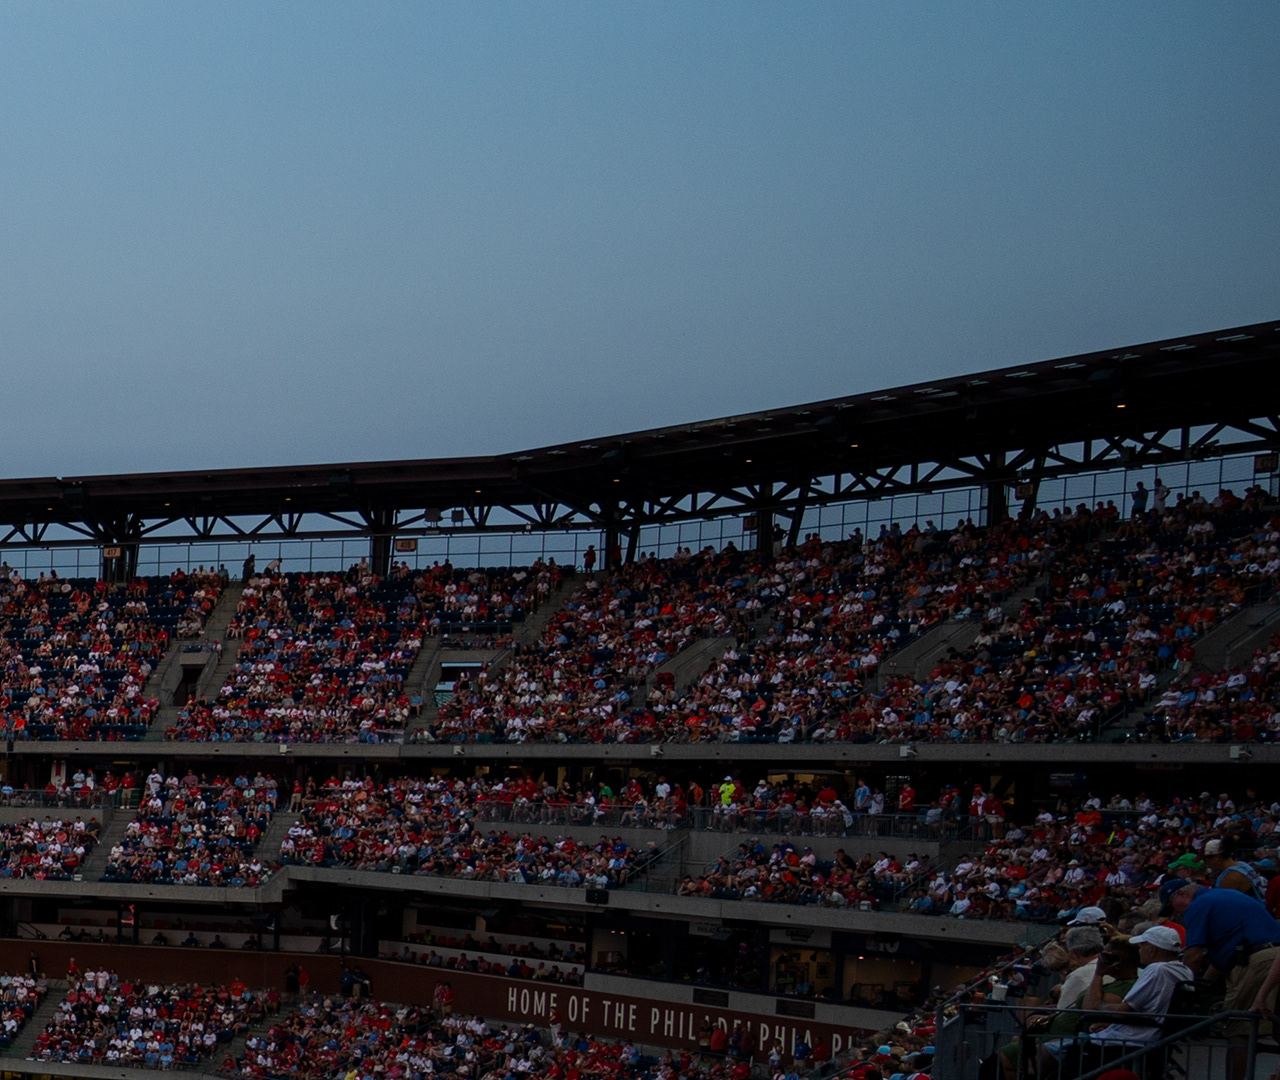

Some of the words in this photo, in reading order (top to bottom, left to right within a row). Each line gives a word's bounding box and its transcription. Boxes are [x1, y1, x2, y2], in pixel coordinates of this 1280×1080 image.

[107, 548, 117, 556] 417
[568, 995, 590, 1023] OF
[602, 1000, 637, 1031] THE
